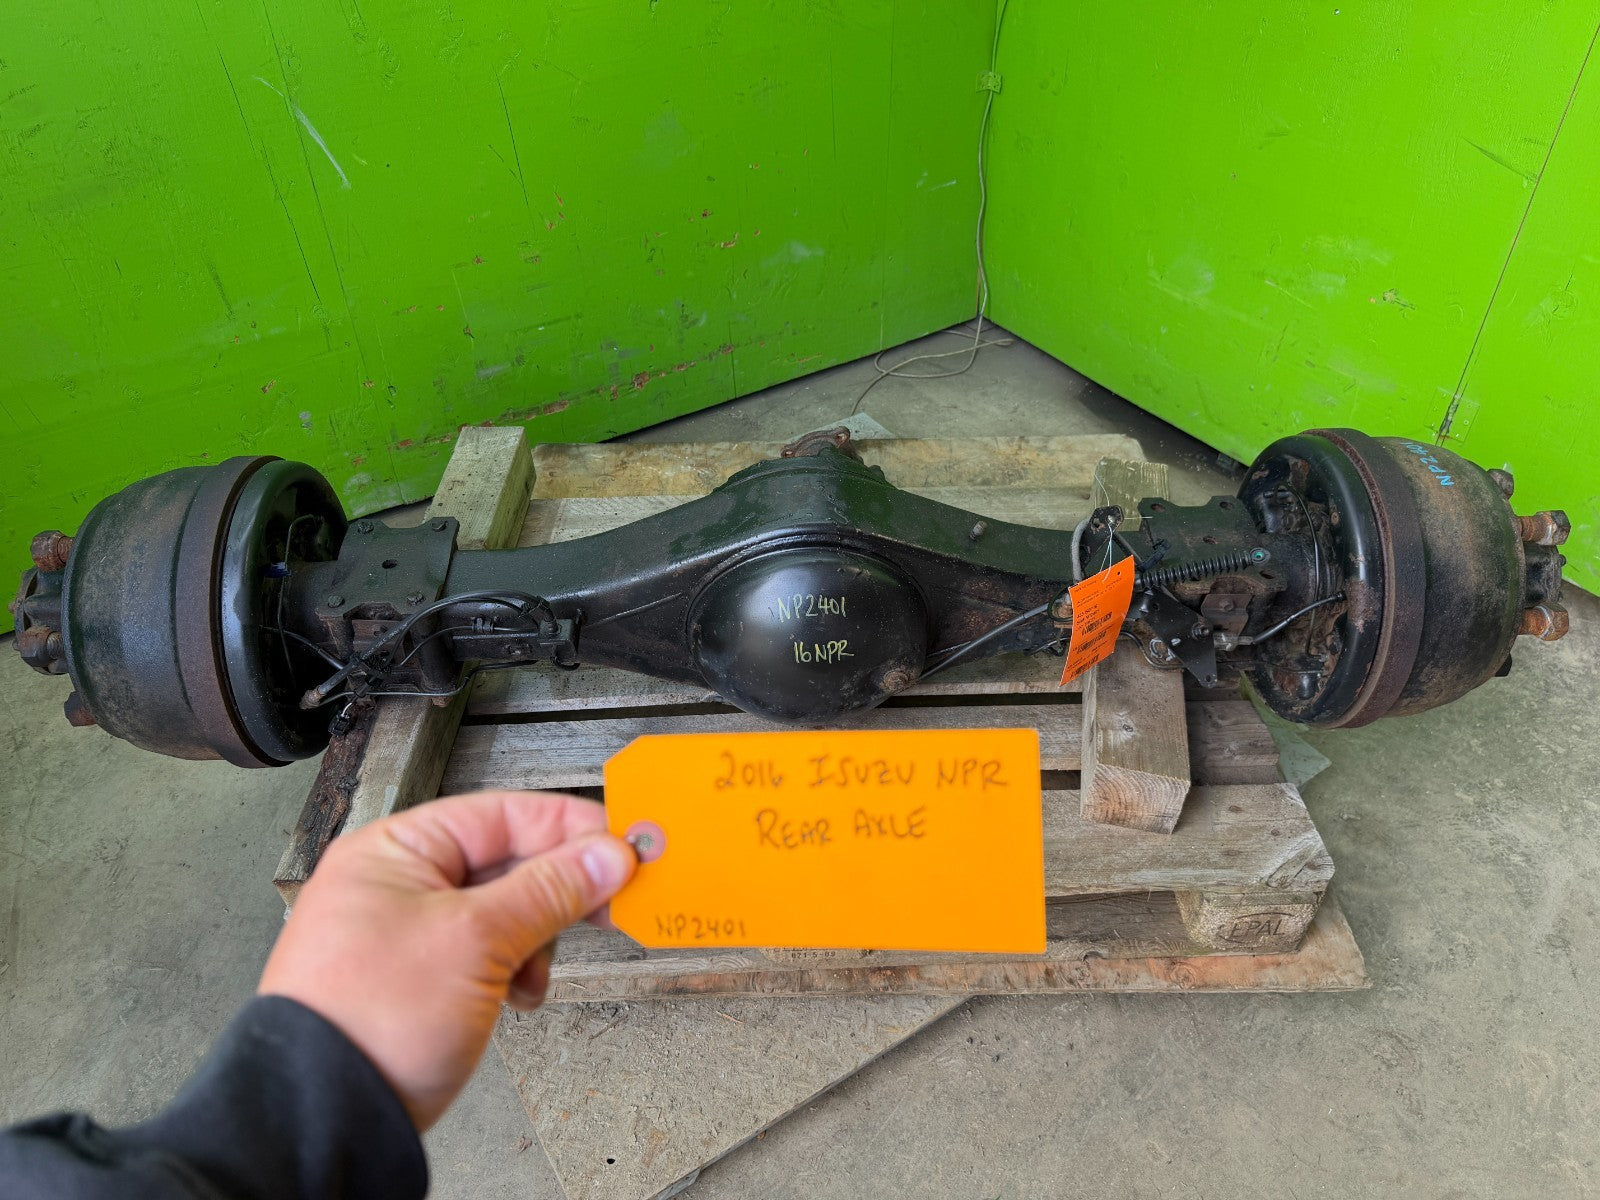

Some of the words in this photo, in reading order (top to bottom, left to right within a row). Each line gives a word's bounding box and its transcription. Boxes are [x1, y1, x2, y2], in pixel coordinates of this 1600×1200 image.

[777, 593, 846, 623] NP2401
[715, 751, 783, 790] 2016
[808, 753, 914, 789] ISUZU
[936, 758, 1008, 790] NPR
[656, 912, 746, 939] NP2401
